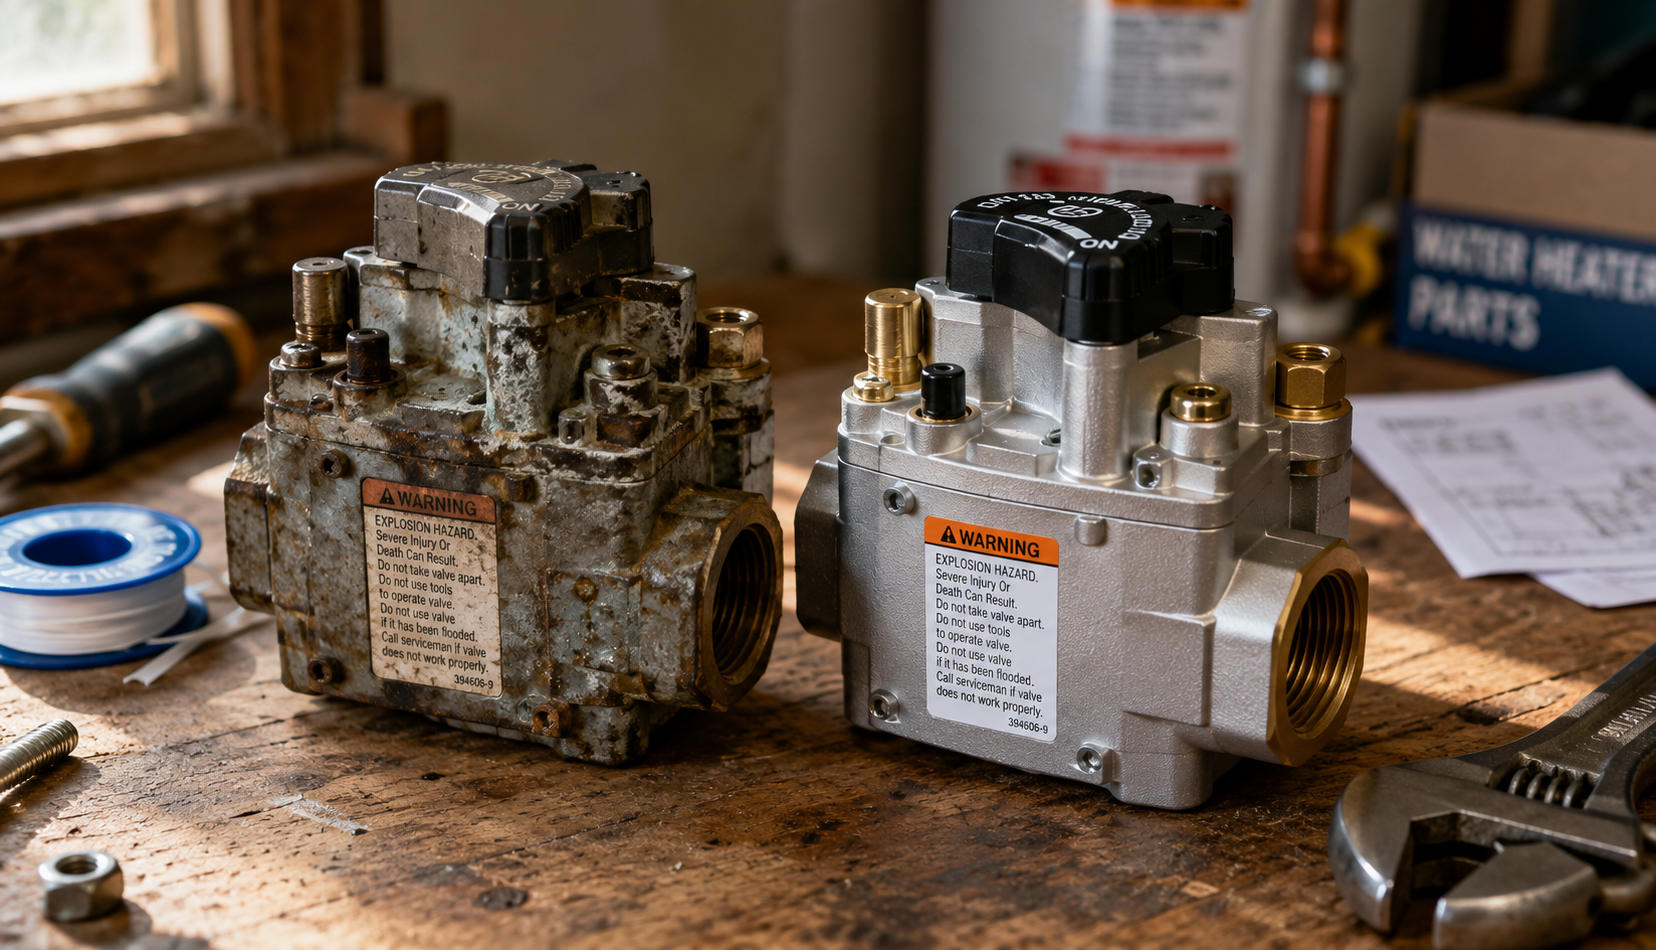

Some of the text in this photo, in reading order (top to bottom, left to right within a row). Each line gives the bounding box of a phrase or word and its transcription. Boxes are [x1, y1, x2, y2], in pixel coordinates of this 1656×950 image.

[1080, 239, 1119, 250] ON
[1414, 217, 1529, 285] WATER
[1409, 275, 1541, 351] PARTS
[397, 491, 477, 517] WARNING
[375, 514, 478, 541] EXPLOSION HAZARD.
[376, 529, 450, 551] Severe Injury Or
[377, 544, 458, 567] Death Can Result.
[959, 529, 1039, 558] WARNING
[378, 558, 485, 586] Do not take valve apart.
[936, 553, 1038, 582] EXPLOSION HAZARD.
[936, 568, 1010, 592] Severe Injury Or
[379, 573, 453, 595] Do not use tools
[936, 583, 1017, 609] Death Can Result.
[379, 588, 455, 610] to operate valve.
[380, 602, 455, 624] Do not use valve
[936, 598, 1044, 629] Do not take valve apart.
[936, 612, 1010, 637] Do not use tools
[381, 617, 478, 642] if it has been flooded.
[936, 628, 1012, 652] to operate valve.
[382, 631, 486, 658] Call serviceman if valve
[936, 641, 1012, 667] Do not use valve
[382, 646, 488, 674] does not work properly.
[937, 656, 1034, 686] if it has been flooded.
[936, 671, 1042, 702] Call serviceman if valve
[937, 685, 1042, 719] does not work properly.
[1009, 717, 1048, 734] 394606-9
